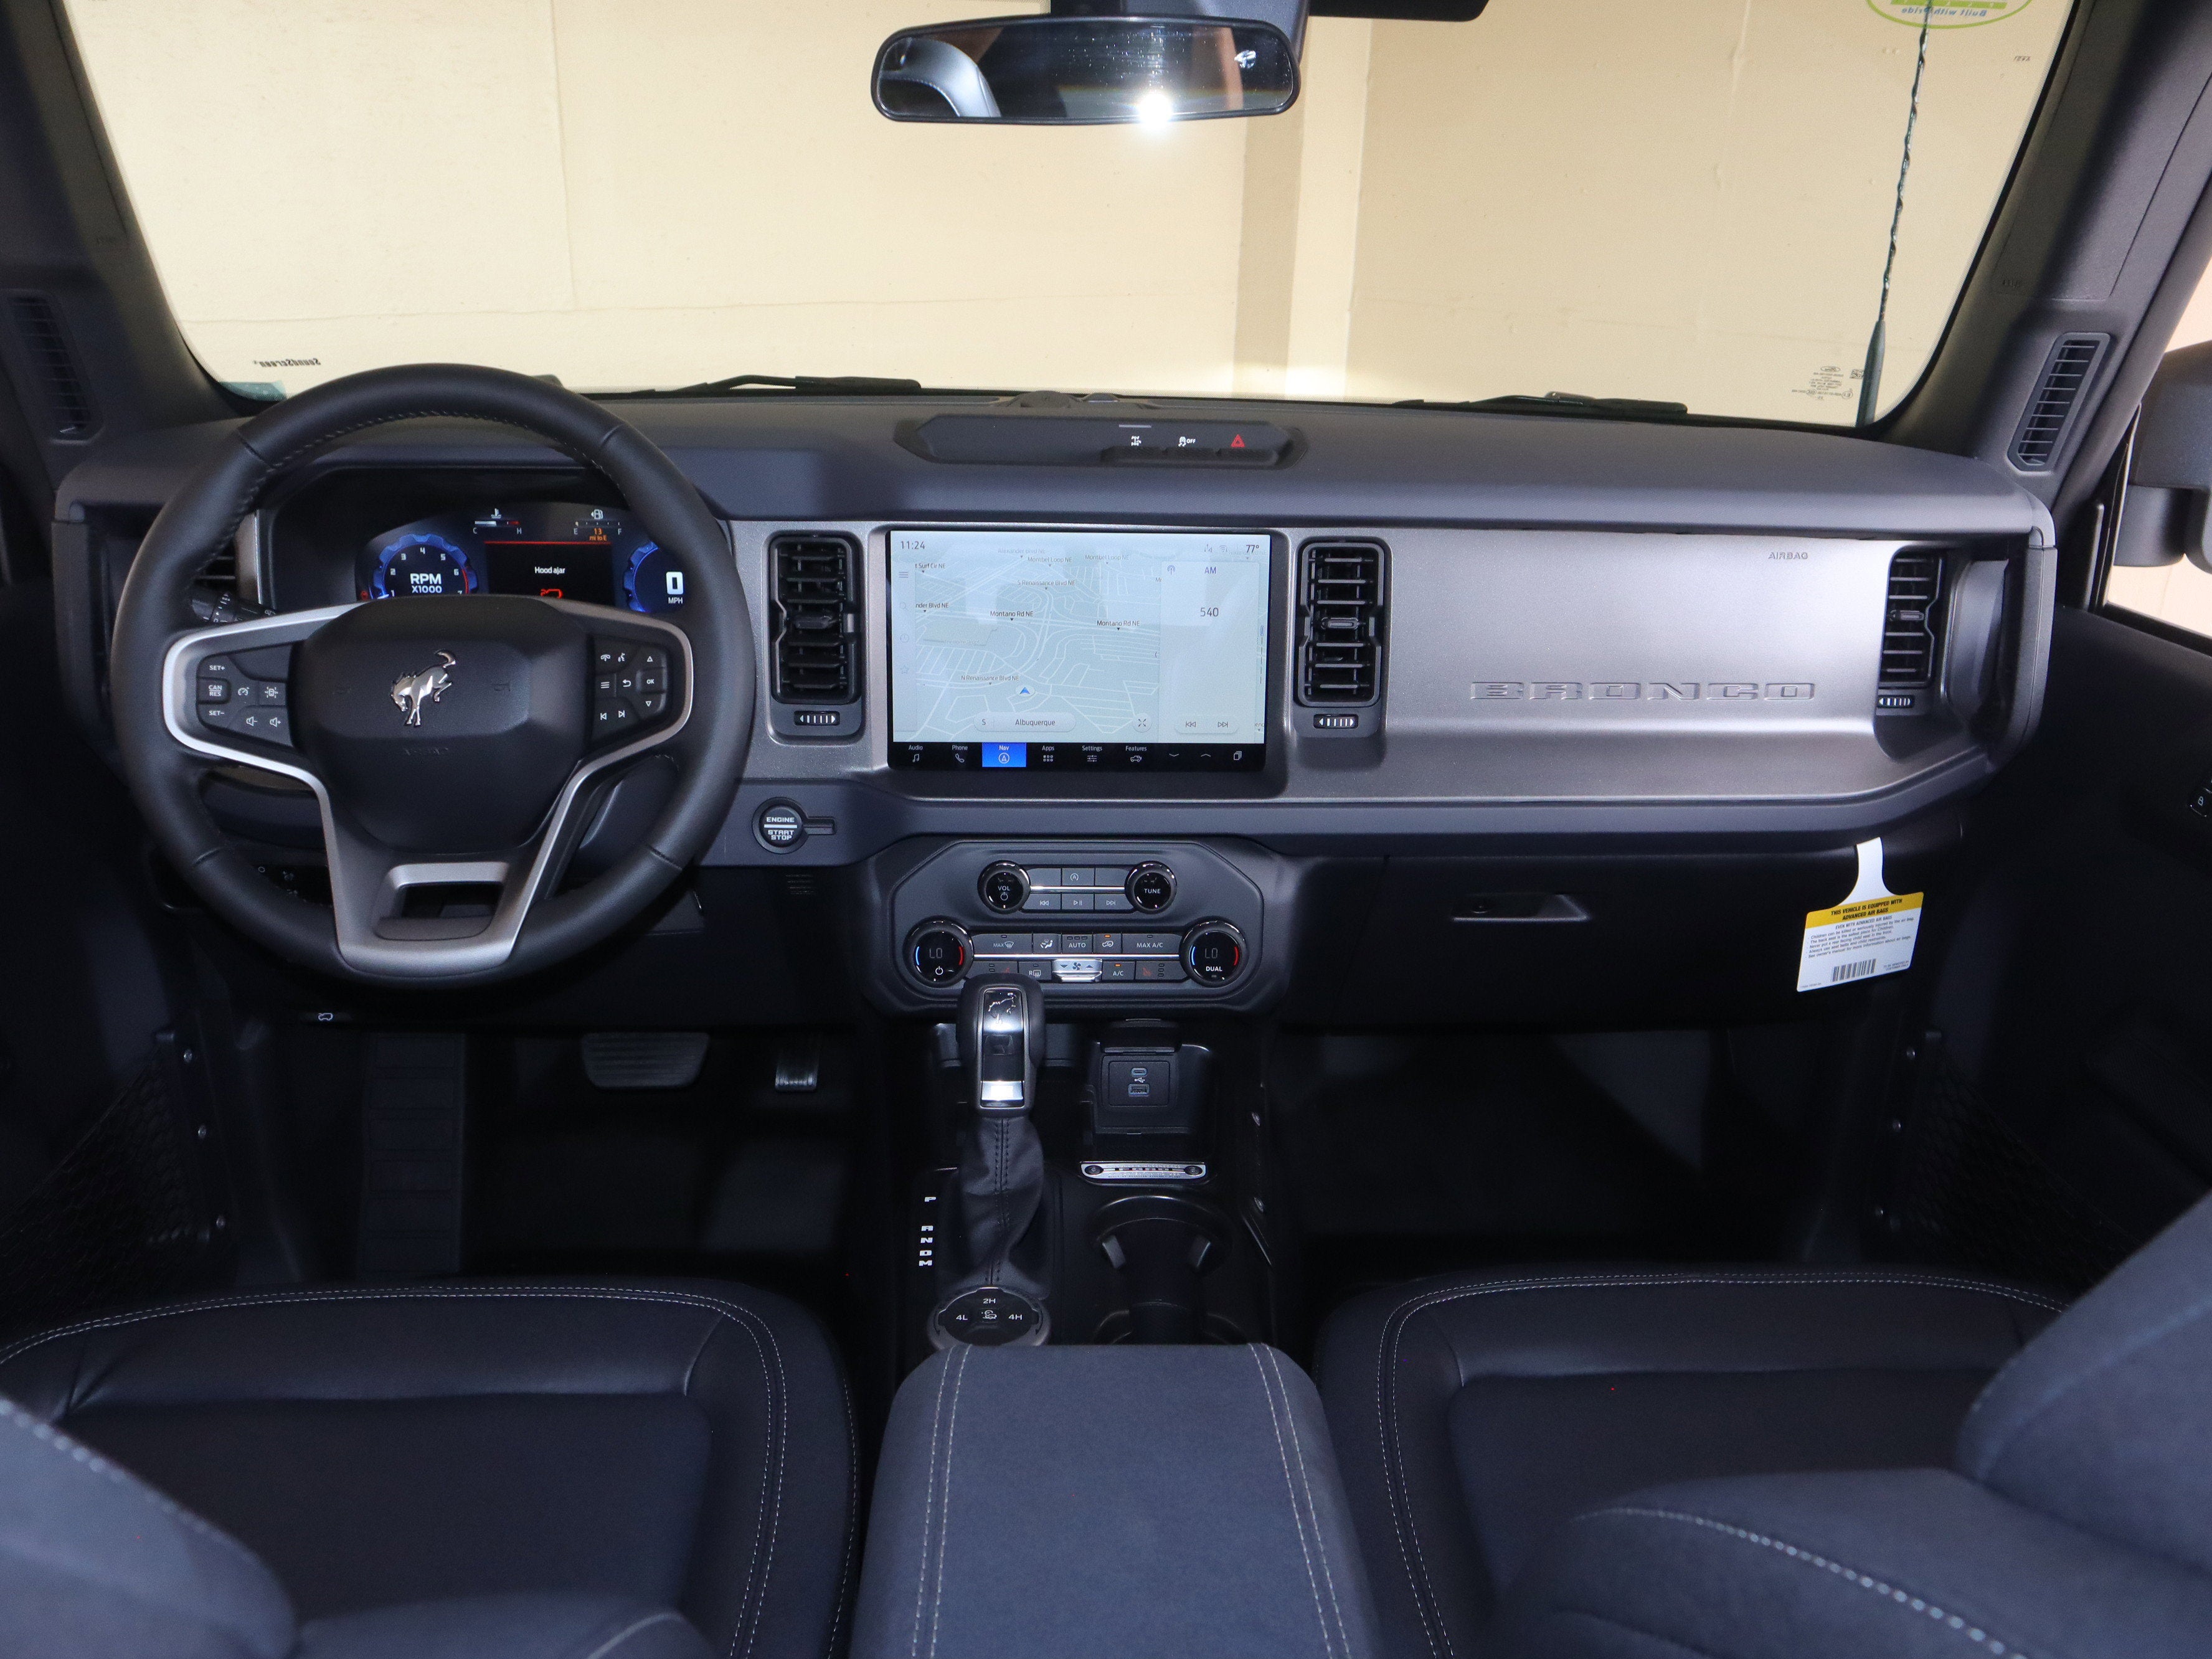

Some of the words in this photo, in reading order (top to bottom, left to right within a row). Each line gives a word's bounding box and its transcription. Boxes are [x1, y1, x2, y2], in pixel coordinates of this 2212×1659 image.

[900, 541, 925, 549] 11:24
[400, 553, 407, 561] 3
[440, 553, 446, 561] 5
[1767, 551, 1808, 560] AIRBAG
[553, 567, 565, 575] ajar
[410, 573, 442, 585] RPM
[666, 572, 683, 594] 0
[411, 585, 442, 593] X1000
[1200, 607, 1219, 617] 540
[1471, 682, 1815, 701] BRONCO
[1842, 905, 1861, 914] VEHICLE
[1868, 900, 1890, 909] EQUIPPED
[1842, 912, 1867, 920] ADVANCED
[929, 947, 943, 959] LO
[1204, 948, 1218, 959] LO
